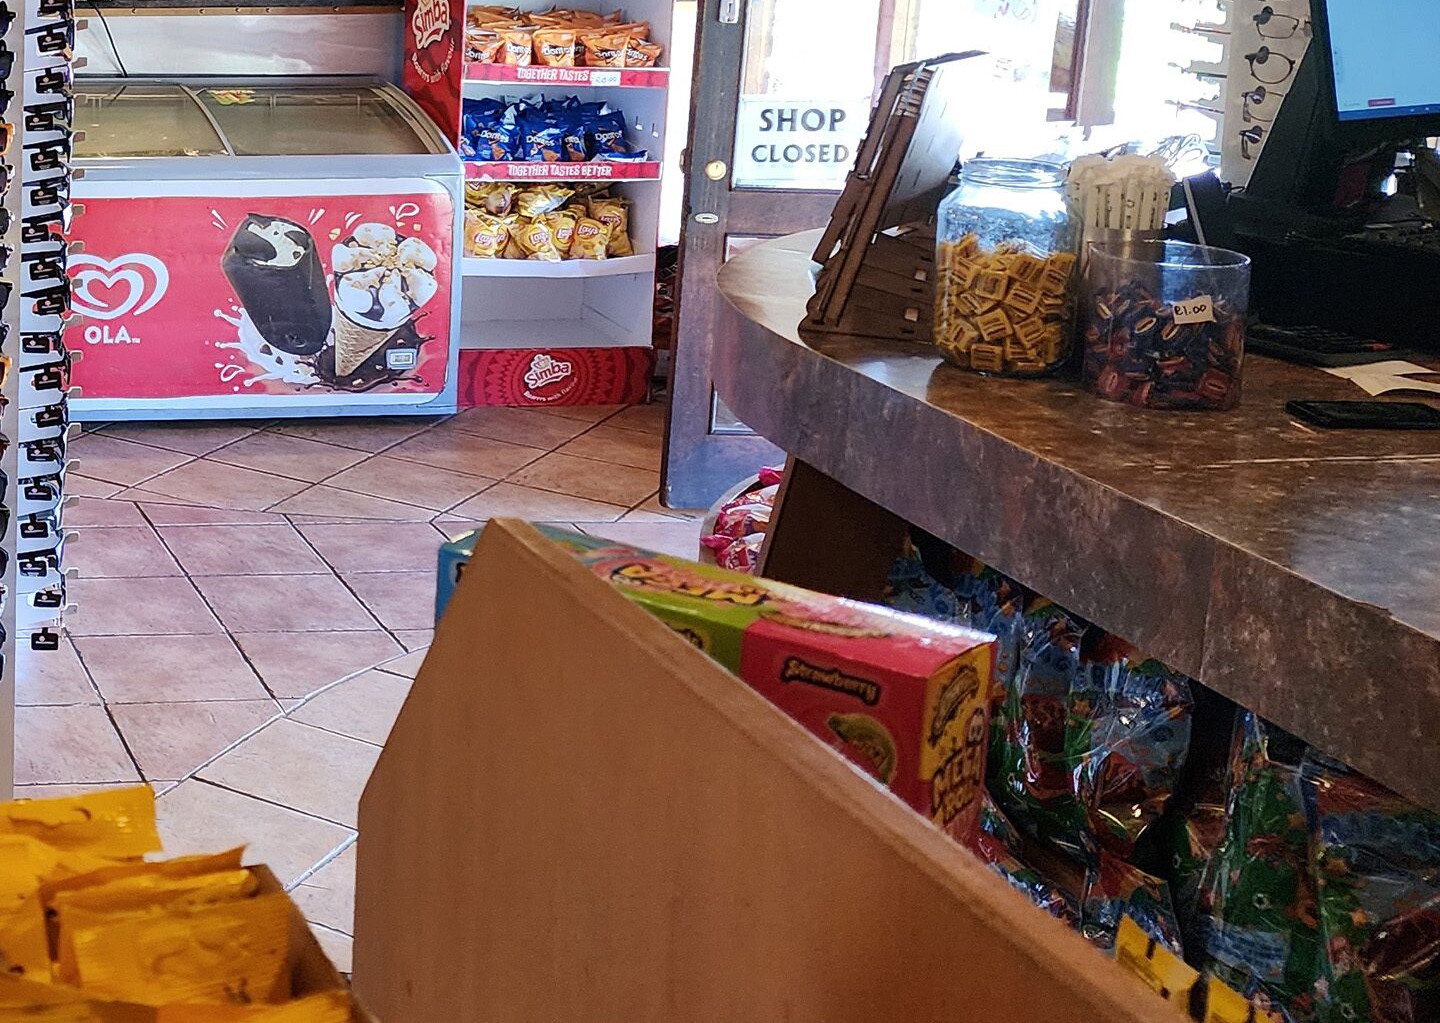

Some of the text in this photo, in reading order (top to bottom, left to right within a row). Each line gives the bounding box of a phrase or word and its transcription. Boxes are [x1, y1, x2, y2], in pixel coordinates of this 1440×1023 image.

[517, 68, 589, 82] TOGETHER TASTES
[759, 108, 847, 132] SHOP
[751, 144, 850, 163] CLOSED
[508, 164, 612, 177] TOGETHER TASTES BETTER
[1174, 304, 1207, 316] R1.00
[84, 324, 132, 345] OLA
[527, 362, 570, 387] Simba
